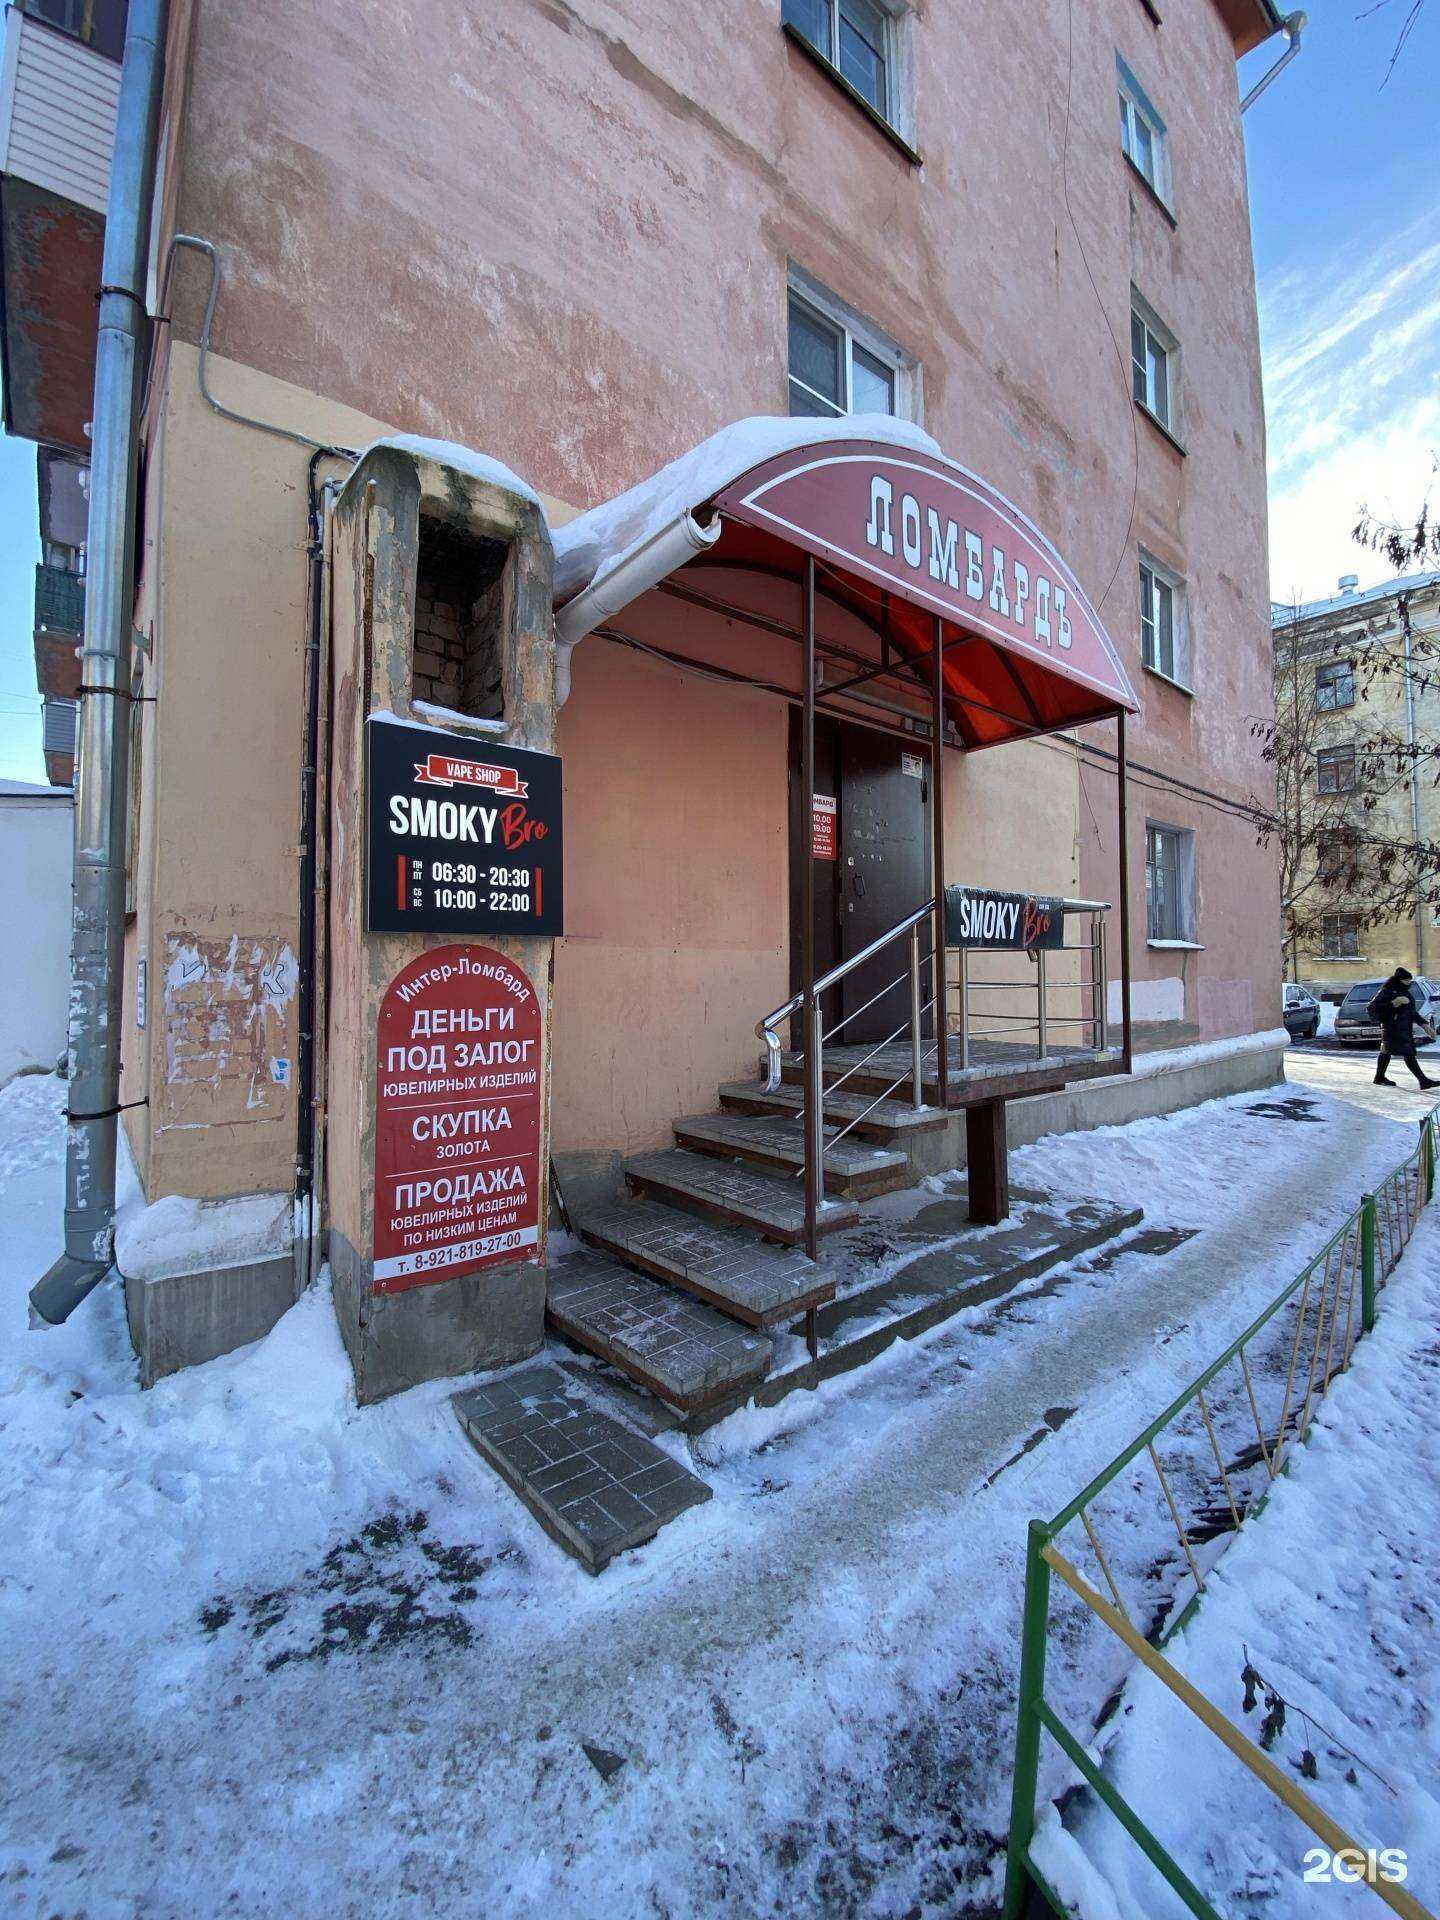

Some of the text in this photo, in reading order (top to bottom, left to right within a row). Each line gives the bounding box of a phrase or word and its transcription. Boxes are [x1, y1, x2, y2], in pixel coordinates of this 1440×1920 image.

[866, 474, 1073, 650] ЛОМБАРДЪ
[447, 763, 502, 784] VAPE SHOP
[389, 795, 549, 850] SMOKY Bro
[413, 860, 423, 869] ПН
[413, 871, 423, 880] ПТ
[432, 861, 477, 884] 06:30
[489, 866, 530, 888] 20:30
[413, 887, 423, 896] СБ
[413, 898, 423, 907] ВС
[433, 888, 477, 909] 10:00
[489, 892, 530, 911] 22:00
[960, 896, 1051, 945] SMOKY Bro
[396, 958, 531, 1003] Интер-Ломбард
[410, 1007, 515, 1039] ДЕНЬГИ
[387, 1039, 535, 1074] ПОД ЗАЛОГ
[383, 1068, 537, 1097] ЮВЕЛИРНЫХ ИЗДЕЛИЙ
[412, 1106, 512, 1142] СКУПКА
[436, 1139, 490, 1159] ЗОЛОТА
[395, 1165, 526, 1211] ПРОДАЖА
[390, 1191, 528, 1231] ЮВЕЛИРНЫХ ИЗДЕЛИЙ
[403, 1211, 517, 1246] ПО НИЗКИМ ЦЕНАМ
[415, 1231, 521, 1270] 8-921-819-27-00
